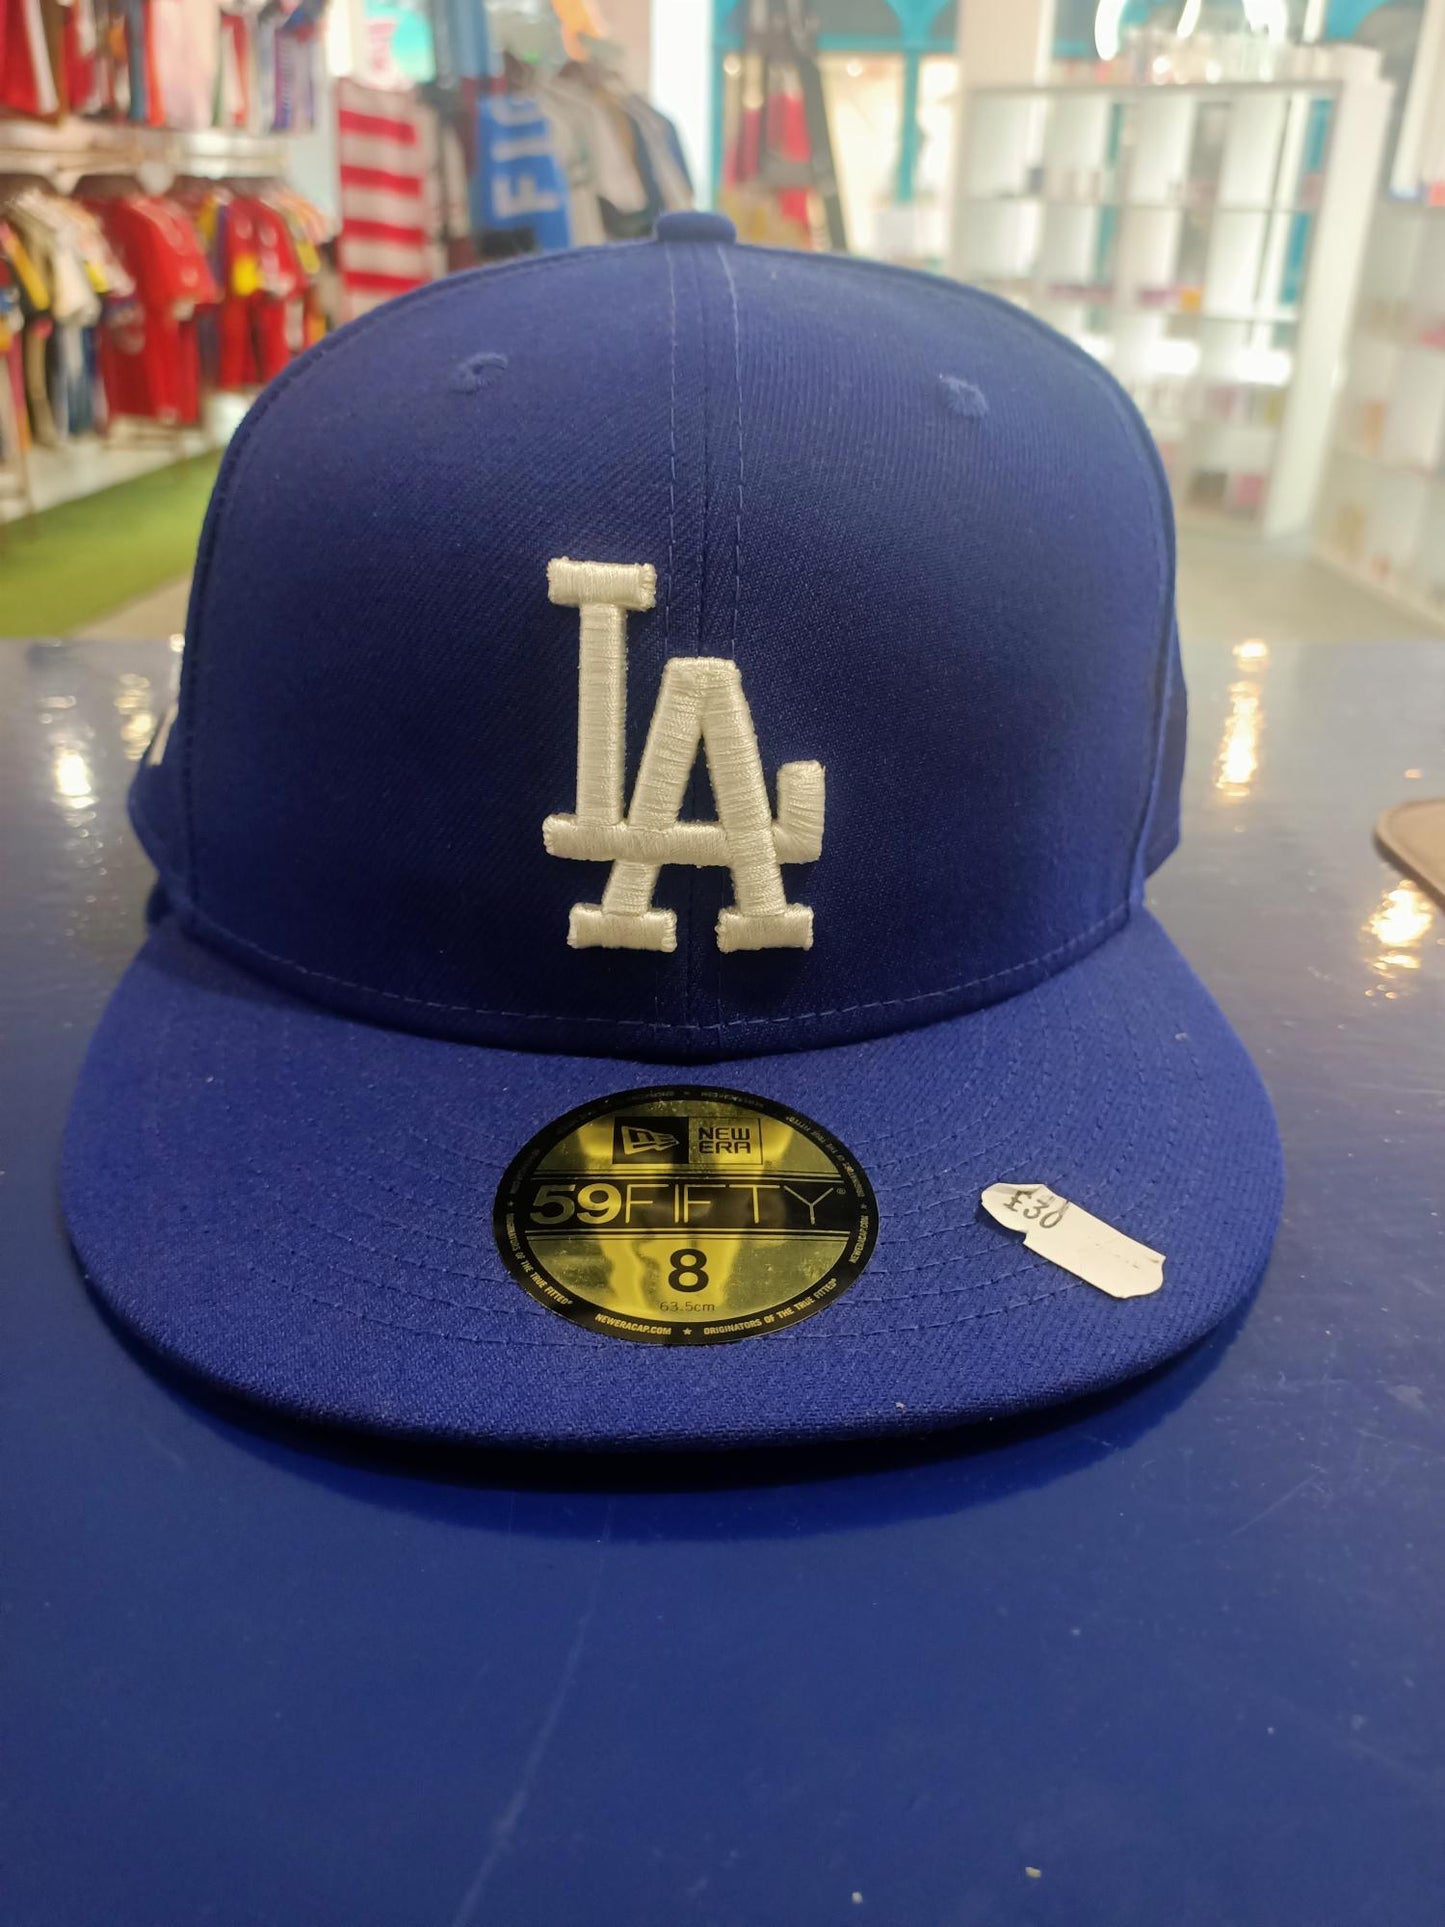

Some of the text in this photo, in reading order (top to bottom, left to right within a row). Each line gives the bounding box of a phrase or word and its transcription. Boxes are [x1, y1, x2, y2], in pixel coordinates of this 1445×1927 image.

[542, 556, 826, 953] LA
[698, 1127, 751, 1140] NEW
[698, 1140, 751, 1154] ERA
[1003, 1190, 1070, 1229] £30
[668, 1248, 709, 1292] 8
[594, 1313, 672, 1335] NEWERACAP.COM
[703, 1318, 762, 1335] ORIGINATORS
[763, 1314, 776, 1324] OF
[776, 1307, 795, 1319] THE
[794, 1296, 816, 1311] TRUE
[660, 1301, 715, 1312] 63.5cm
